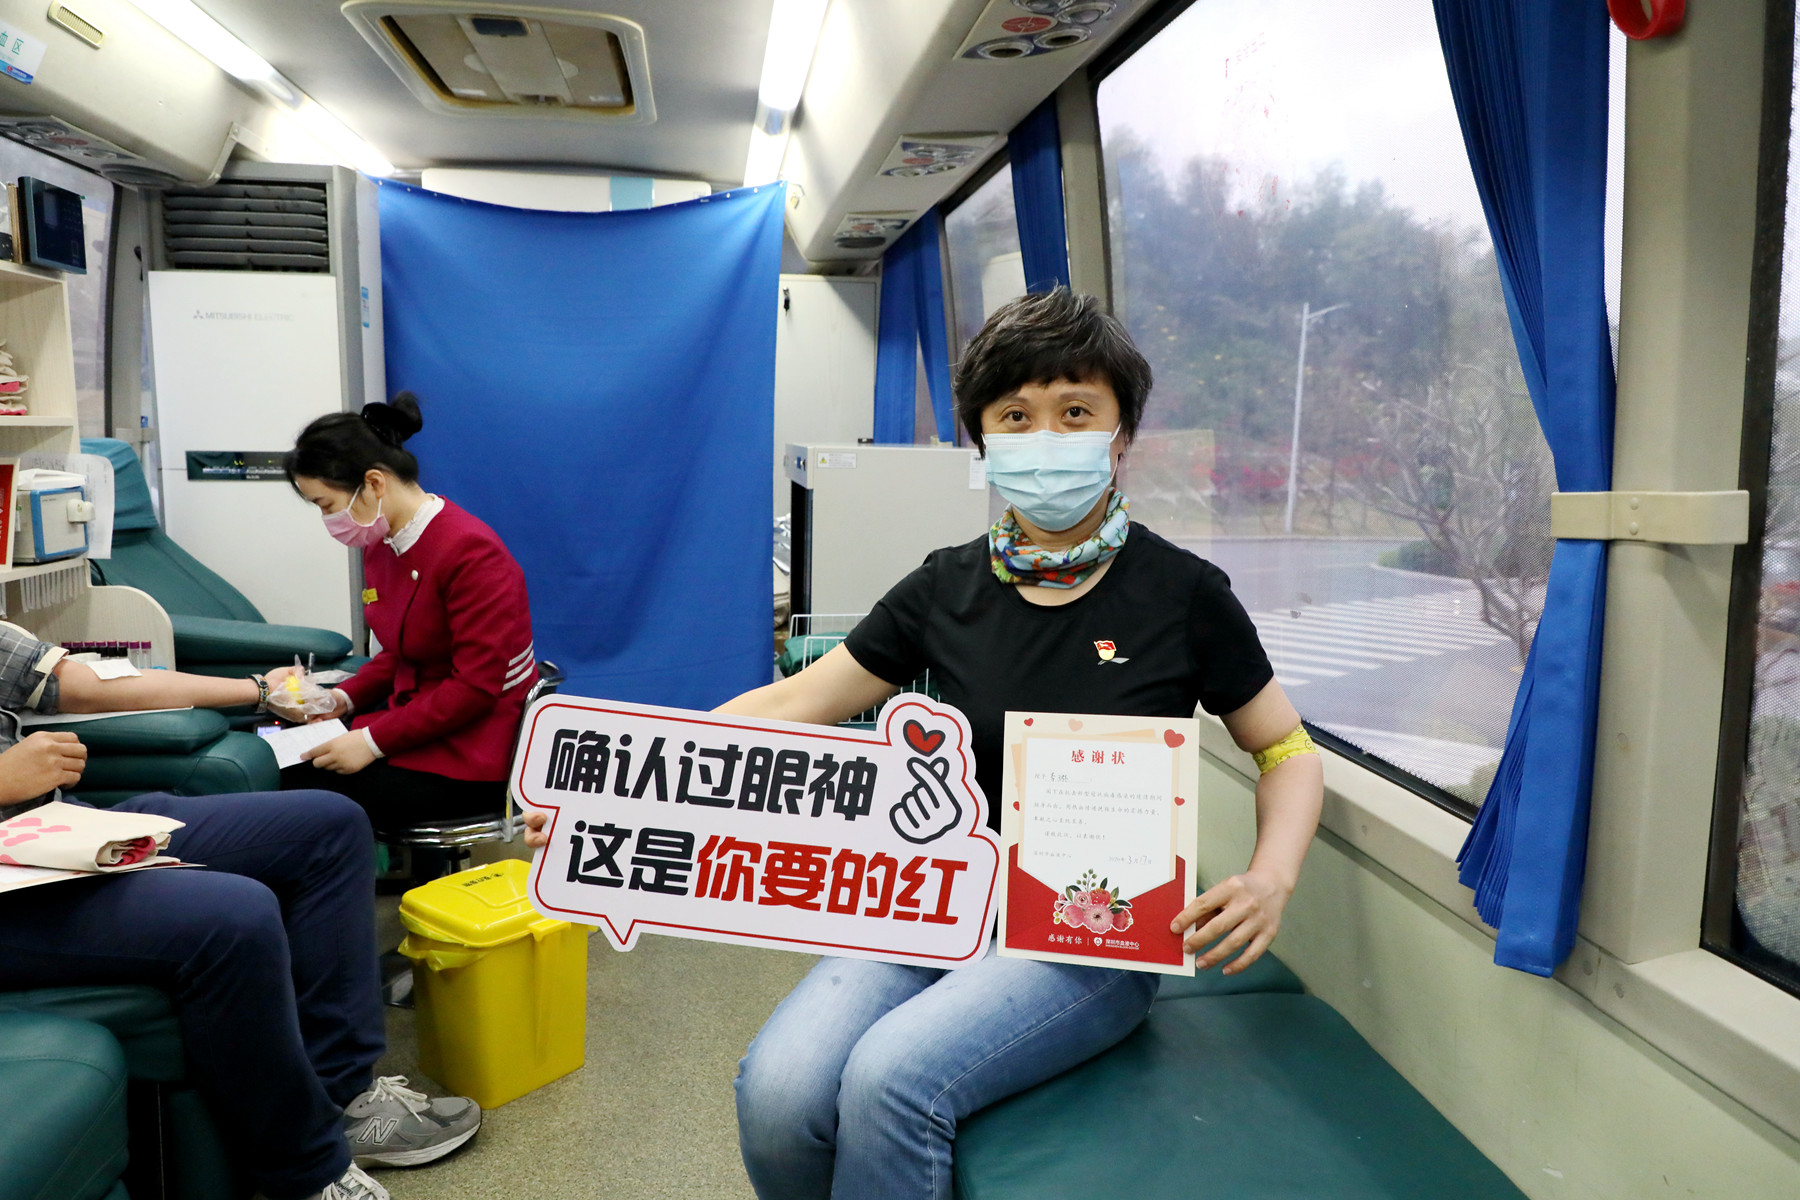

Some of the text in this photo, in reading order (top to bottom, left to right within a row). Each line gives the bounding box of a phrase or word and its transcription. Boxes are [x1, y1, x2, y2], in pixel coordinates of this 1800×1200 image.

[205, 311, 252, 320] MITSUBISHI
[1072, 749, 1125, 765] 感谢状
[544, 728, 878, 822] 确认过眼神
[567, 819, 969, 925] 这是你要的红
[1048, 933, 1083, 944] 感谢有你
[356, 1116, 399, 1146] N
